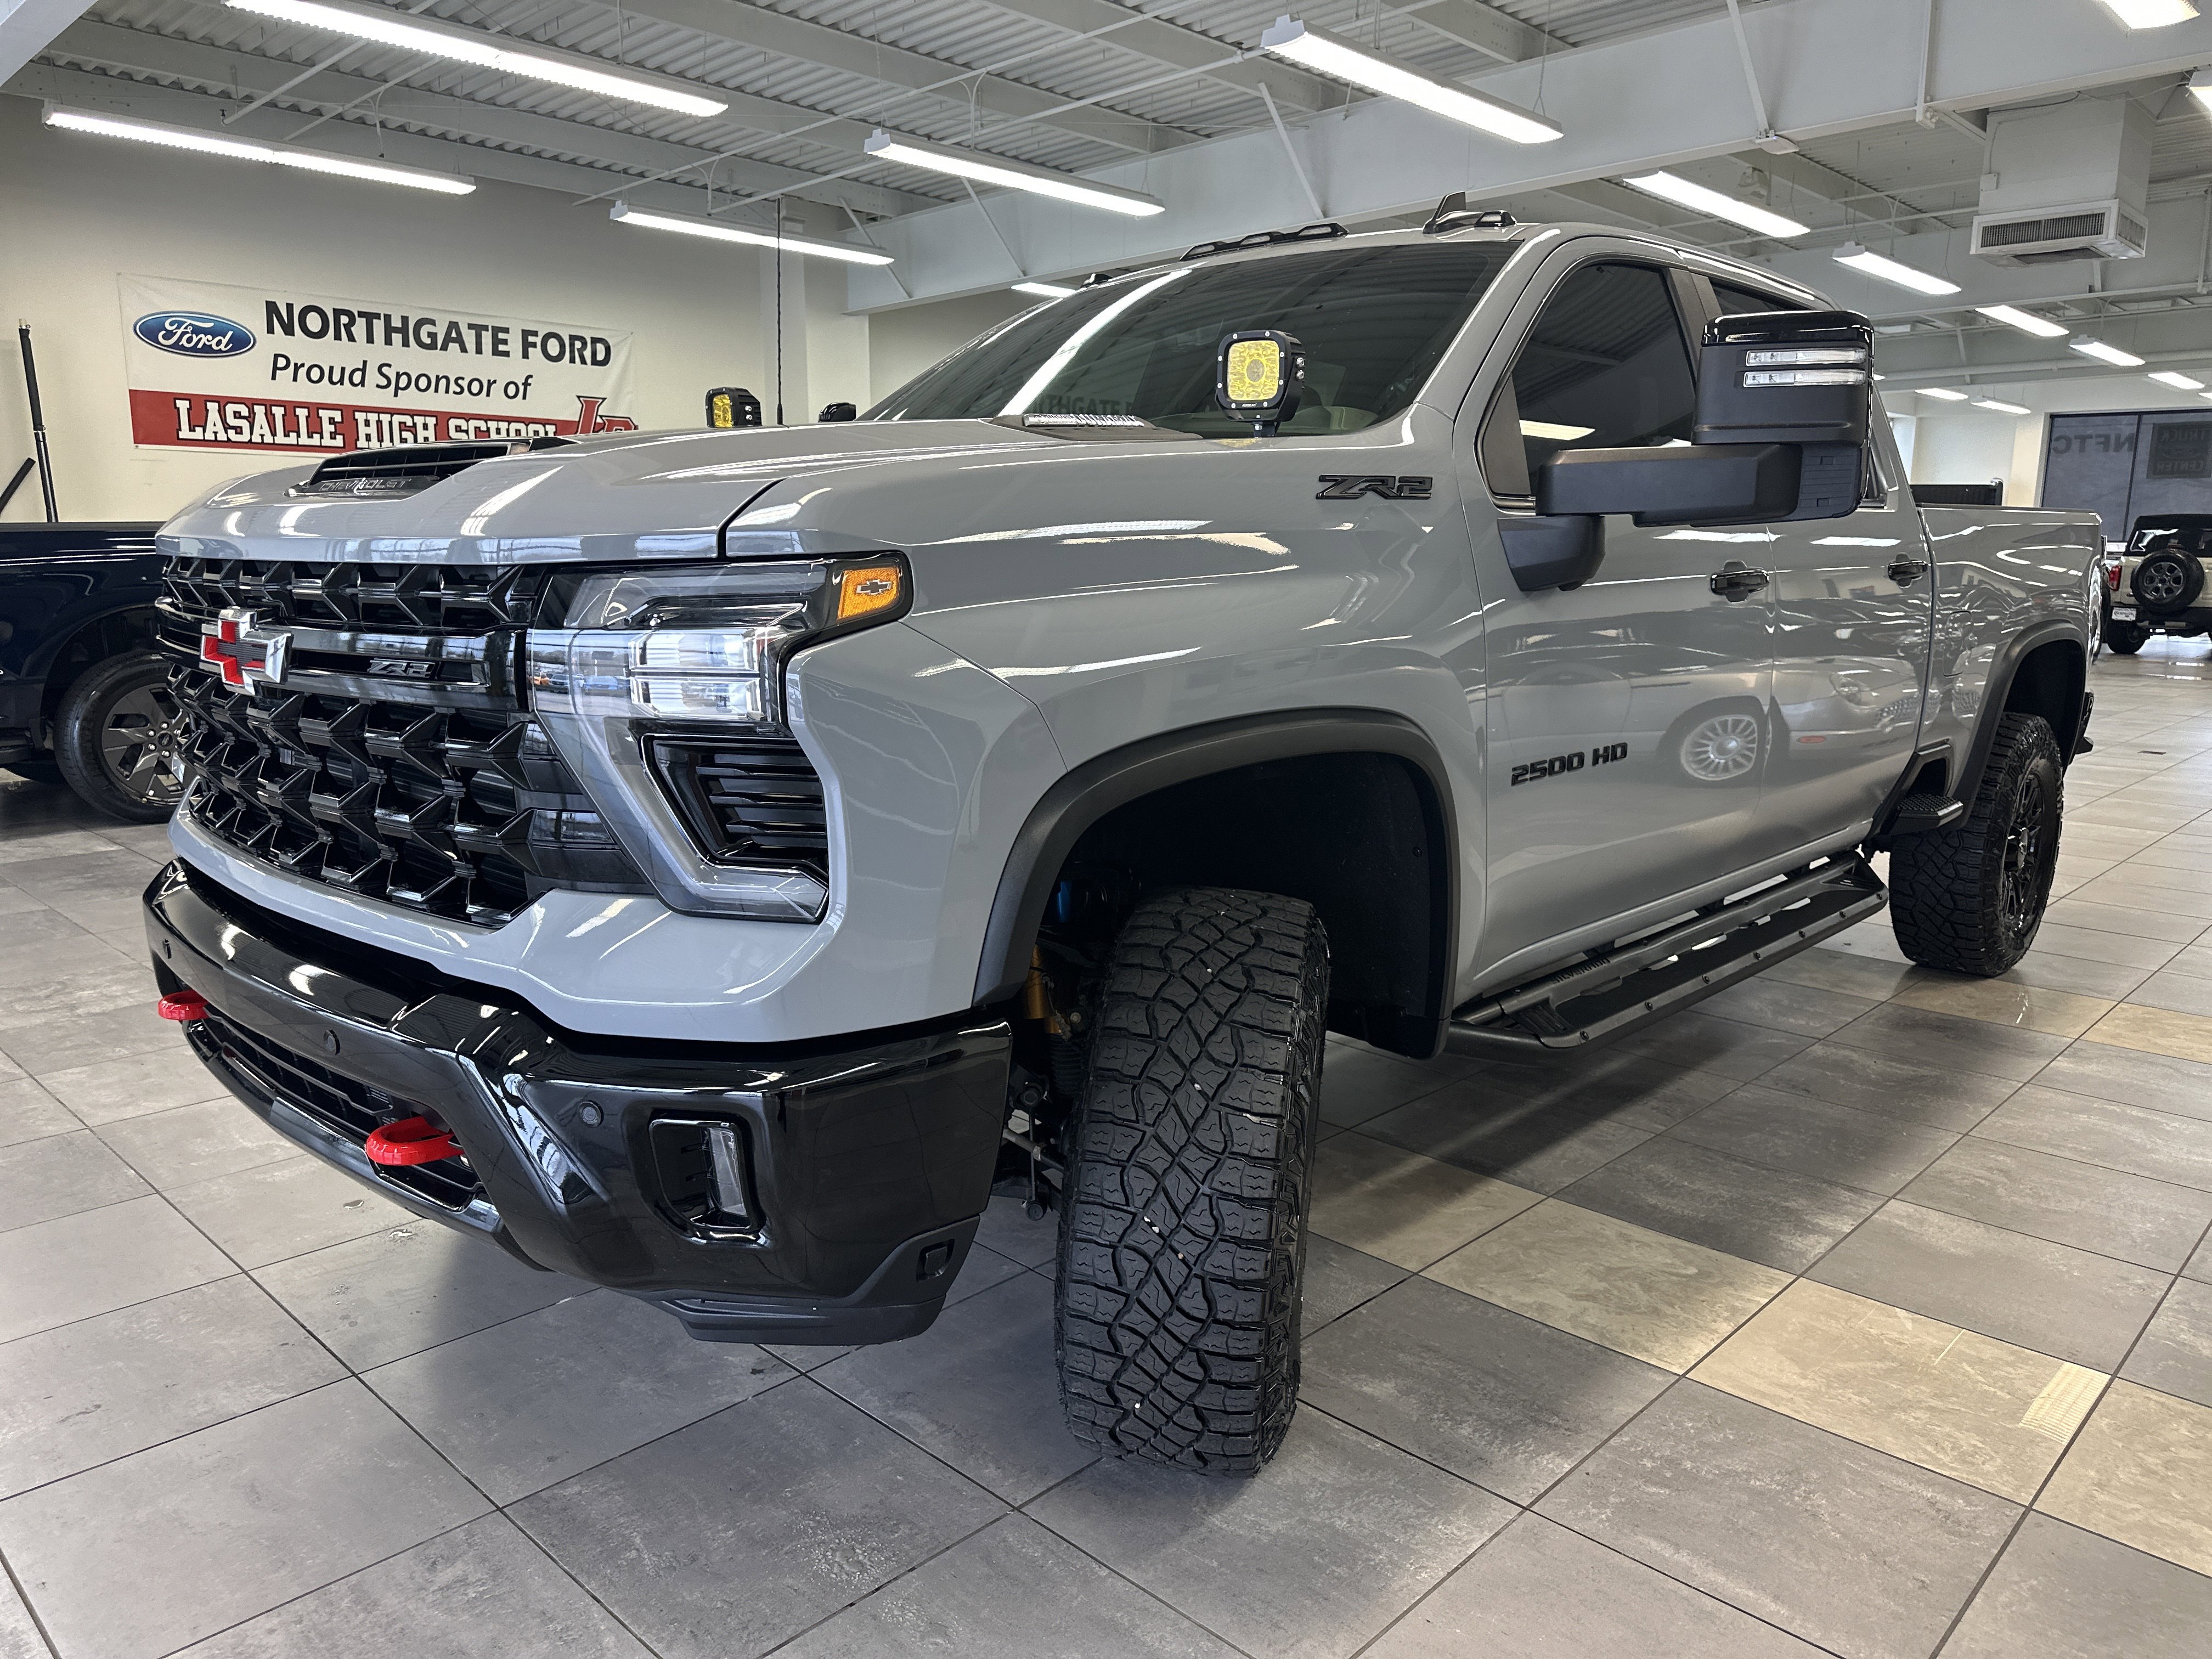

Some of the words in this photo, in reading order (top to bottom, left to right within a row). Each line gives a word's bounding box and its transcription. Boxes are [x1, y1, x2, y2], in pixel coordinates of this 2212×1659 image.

[157, 317, 233, 352] Ford
[265, 300, 511, 358] NORTHGATE
[521, 329, 612, 367] FORD
[270, 353, 368, 387] Proud
[375, 362, 497, 398] Sponsor
[503, 374, 533, 400] of
[173, 397, 346, 449] LASALLE
[353, 410, 438, 449] HIGH
[1315, 475, 1433, 500] ZR2
[367, 659, 431, 678] ZR2
[1511, 751, 1585, 787] 2500
[1592, 742, 1628, 766] HD
